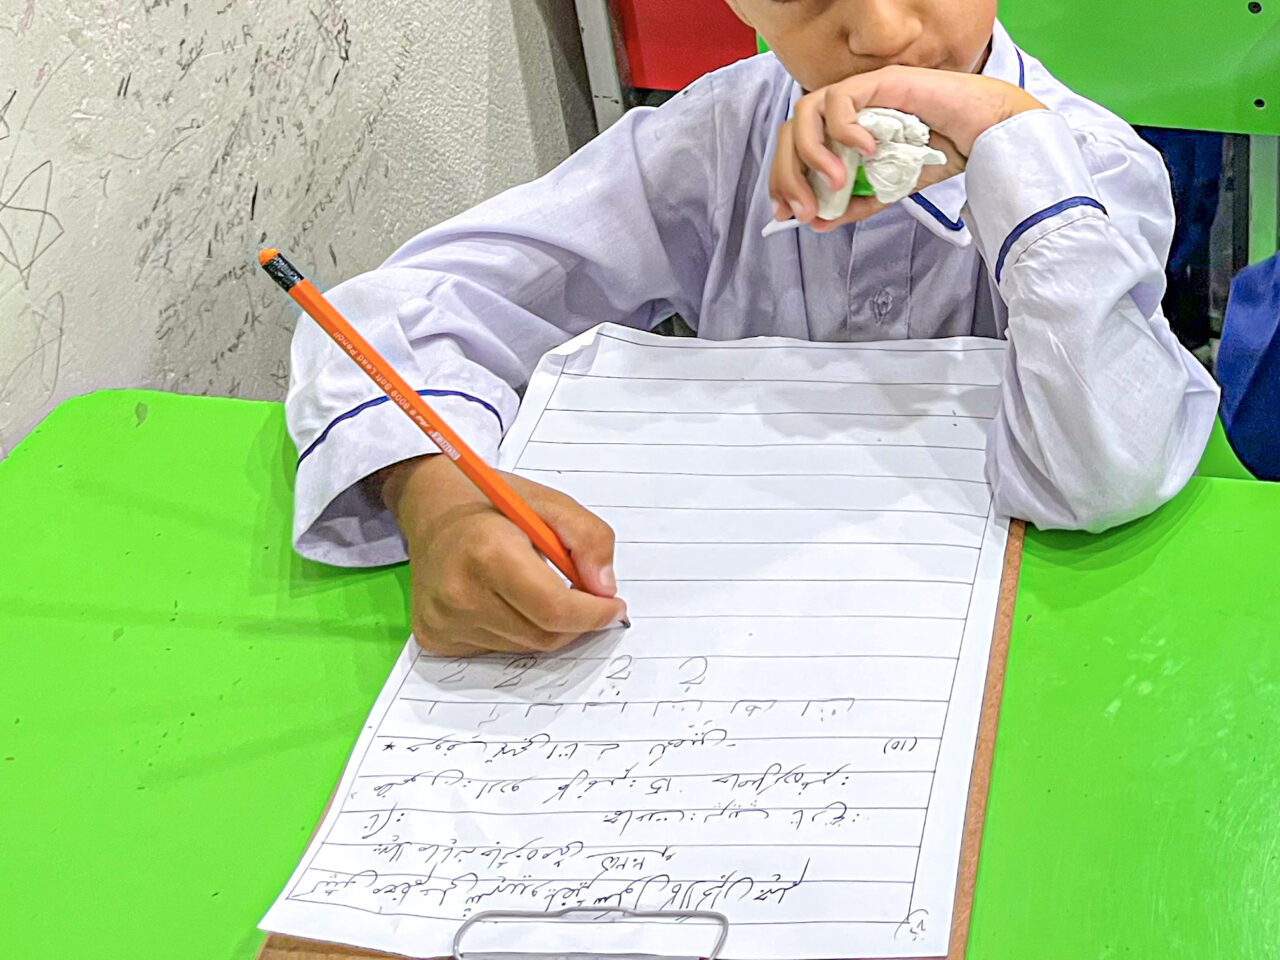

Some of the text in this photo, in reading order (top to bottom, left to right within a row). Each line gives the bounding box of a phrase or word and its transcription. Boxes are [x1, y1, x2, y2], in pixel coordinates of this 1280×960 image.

[332, 329, 358, 356] Pencil
[355, 353, 377, 375] Lead
[374, 372, 393, 391] Soft
[881, 736, 918, 755] (10)
[644, 776, 672, 795] 15
